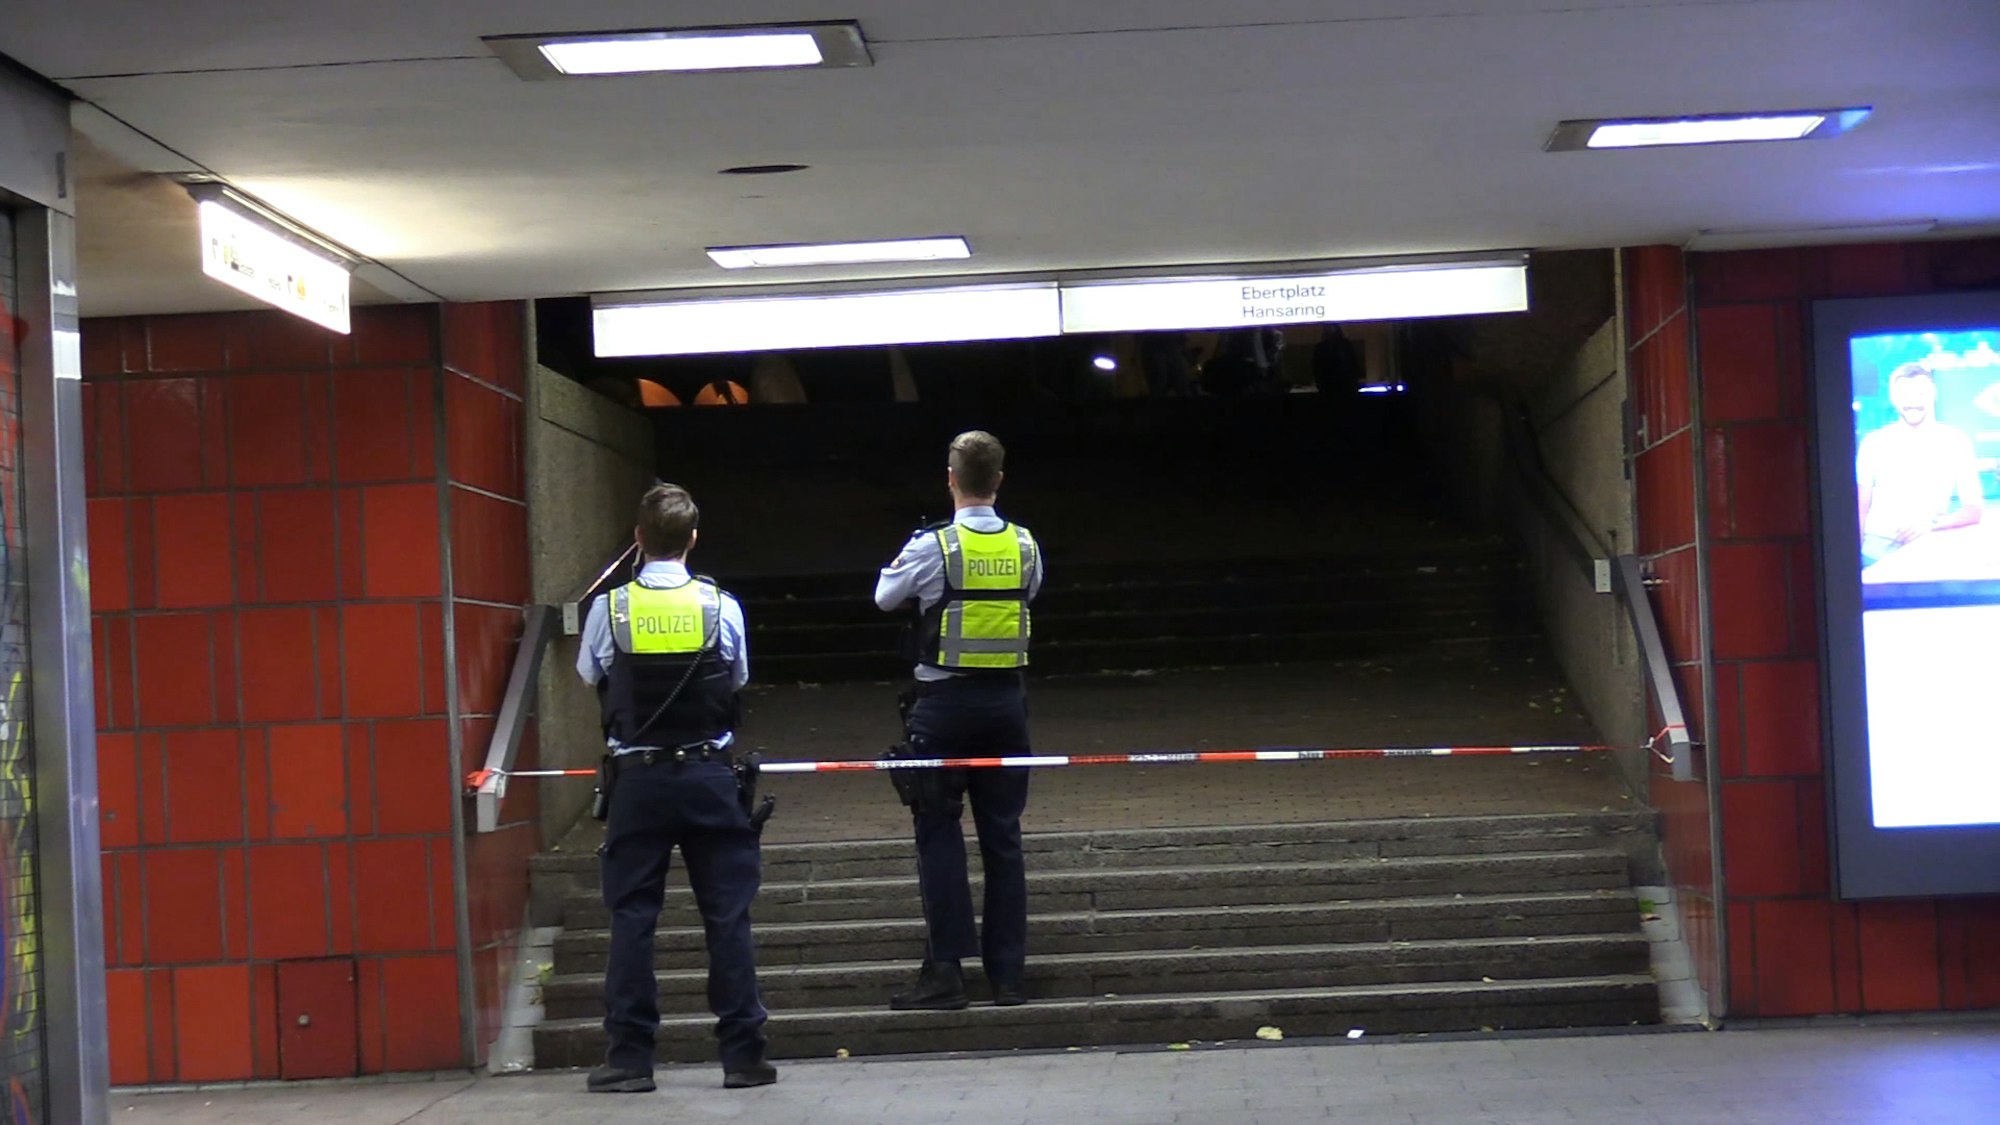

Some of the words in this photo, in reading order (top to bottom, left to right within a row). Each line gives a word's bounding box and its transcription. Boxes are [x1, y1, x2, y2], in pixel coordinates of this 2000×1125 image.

[1242, 285, 1325, 300] Ebertplatz
[1243, 304, 1325, 318] Hansaring
[968, 559, 1017, 576] POLIZEI
[637, 615, 697, 634] POLIZEI
